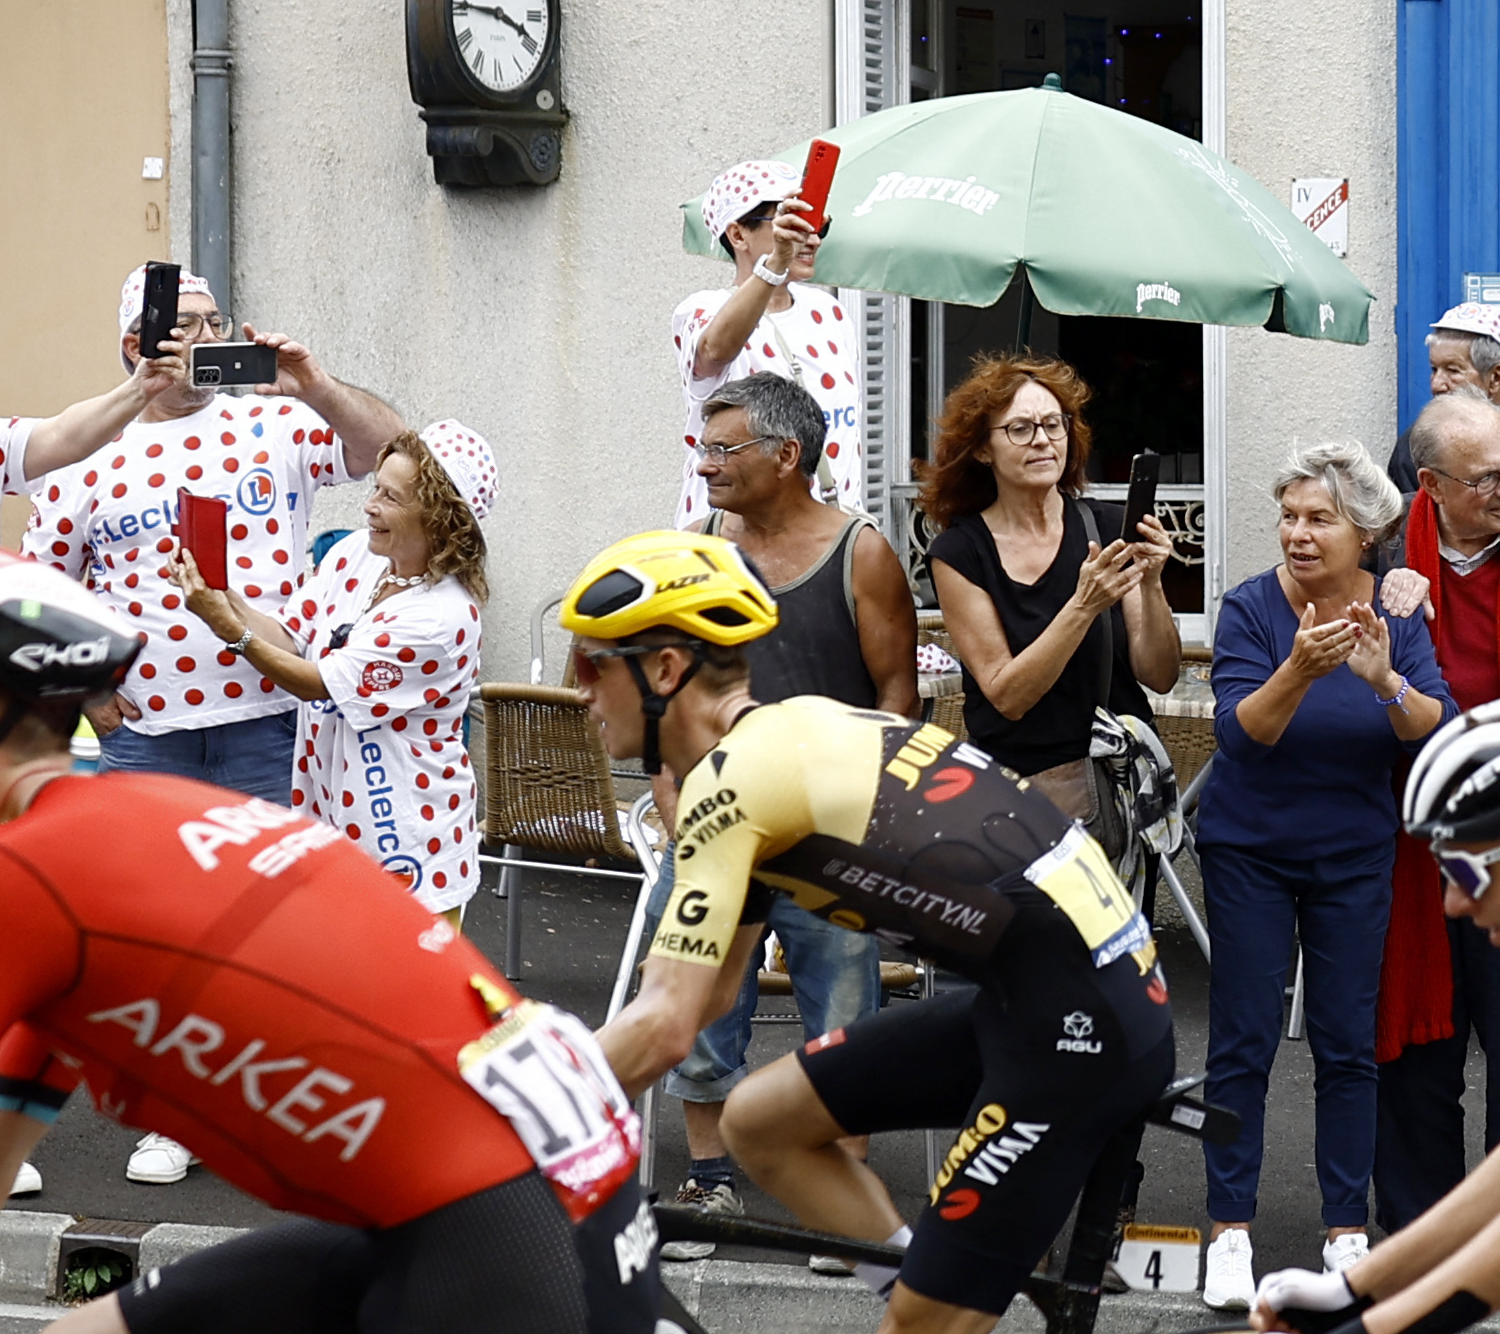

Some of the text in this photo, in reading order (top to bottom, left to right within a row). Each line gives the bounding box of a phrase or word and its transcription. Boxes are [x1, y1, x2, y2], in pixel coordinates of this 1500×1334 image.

[1296, 188, 1312, 204] IV
[653, 572, 712, 595] LAZER
[677, 788, 738, 841] UMBO
[695, 806, 748, 846] VISMA
[654, 931, 721, 961] HEMA
[1056, 1039, 1103, 1054] AGU
[88, 998, 386, 1164] ARKEA
[1143, 1249, 1165, 1289] 4
